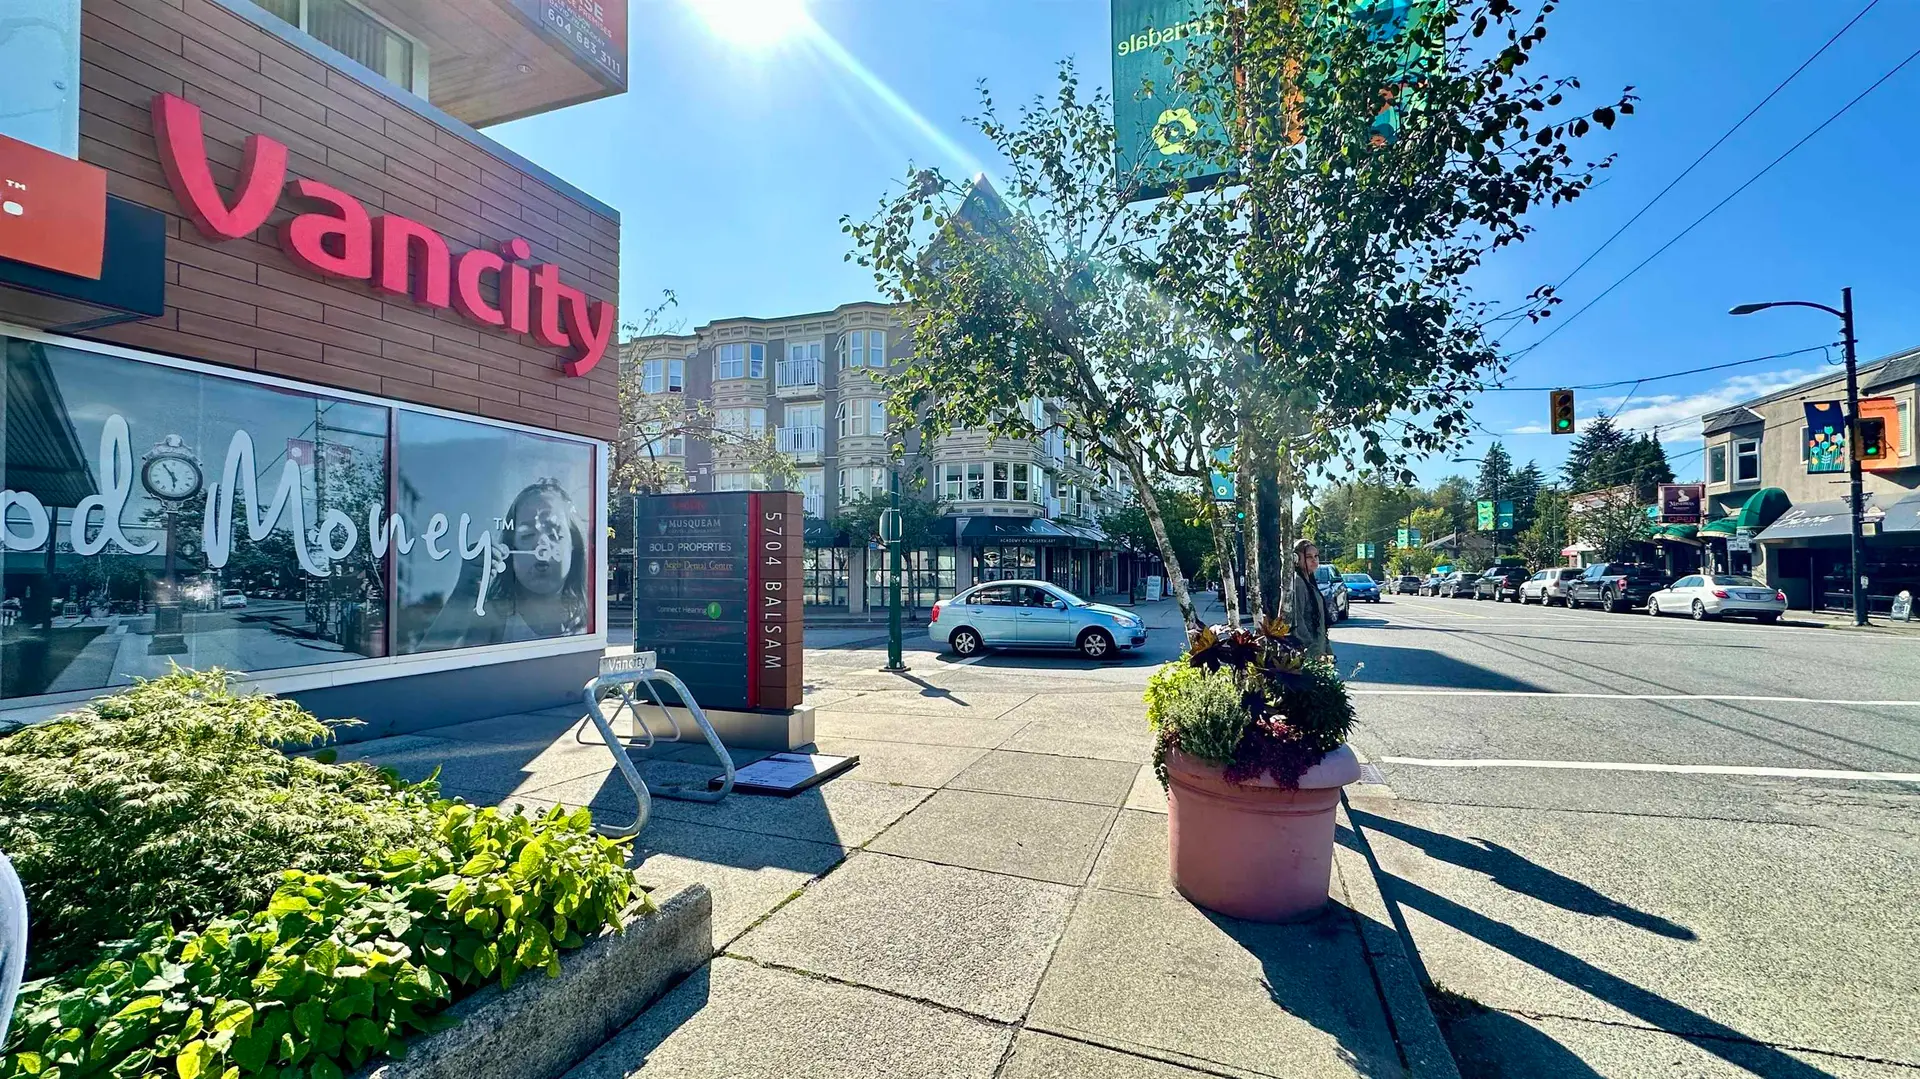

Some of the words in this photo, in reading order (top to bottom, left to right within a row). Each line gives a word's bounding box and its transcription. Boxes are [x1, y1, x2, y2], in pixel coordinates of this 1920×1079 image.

[548, 8, 571, 34] 604
[576, 31, 597, 54] 683
[600, 50, 620, 74] 3111
[152, 92, 613, 377] Vancity
[205, 429, 491, 617] Money
[649, 542, 674, 552] BOLD
[677, 542, 732, 552] PROPERTIES
[668, 519, 721, 529] MUSQUEAM
[765, 512, 782, 566] 5704
[657, 605, 681, 613] Connect
[683, 605, 708, 615] Hearing
[765, 582, 782, 669] BALSAM
[608, 656, 648, 671] Vancity
